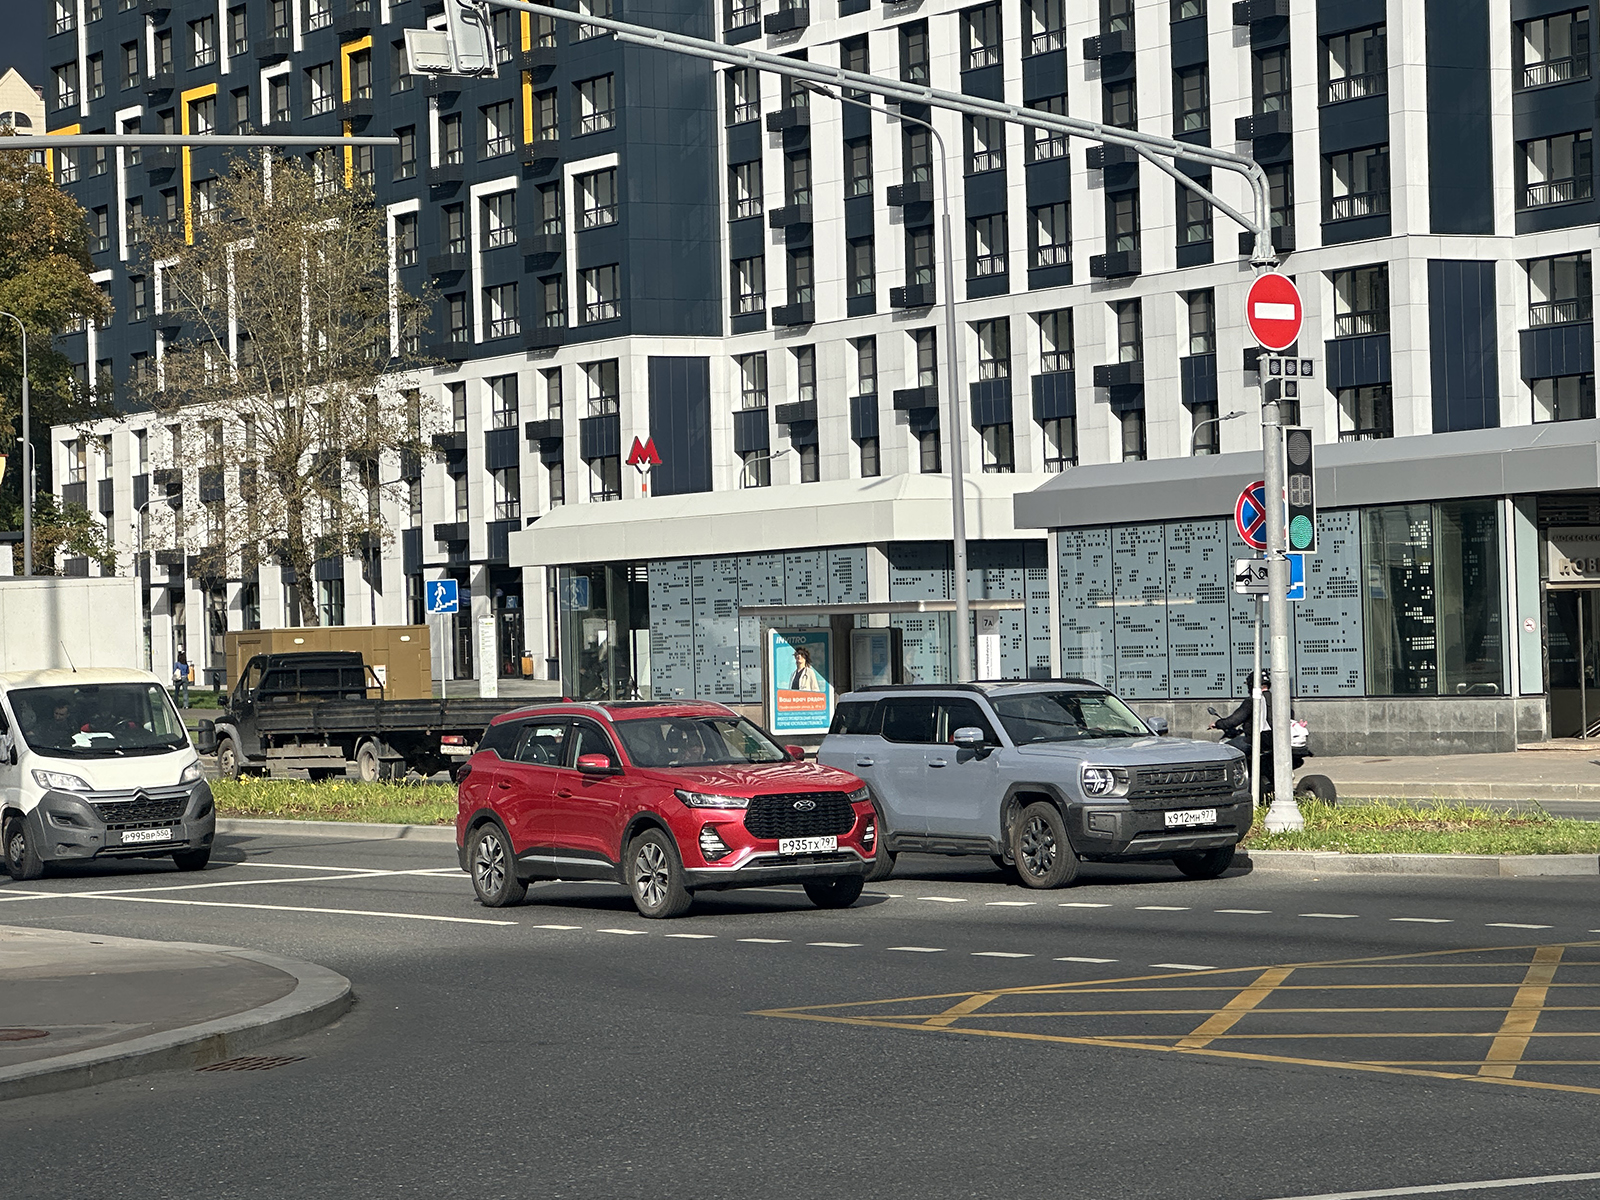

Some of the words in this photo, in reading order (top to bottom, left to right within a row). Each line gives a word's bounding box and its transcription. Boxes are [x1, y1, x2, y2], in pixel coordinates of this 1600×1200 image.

[1558, 558, 1600, 576] НОВ
[775, 636, 807, 644] INVITRO
[1149, 769, 1219, 784] HAVAL
